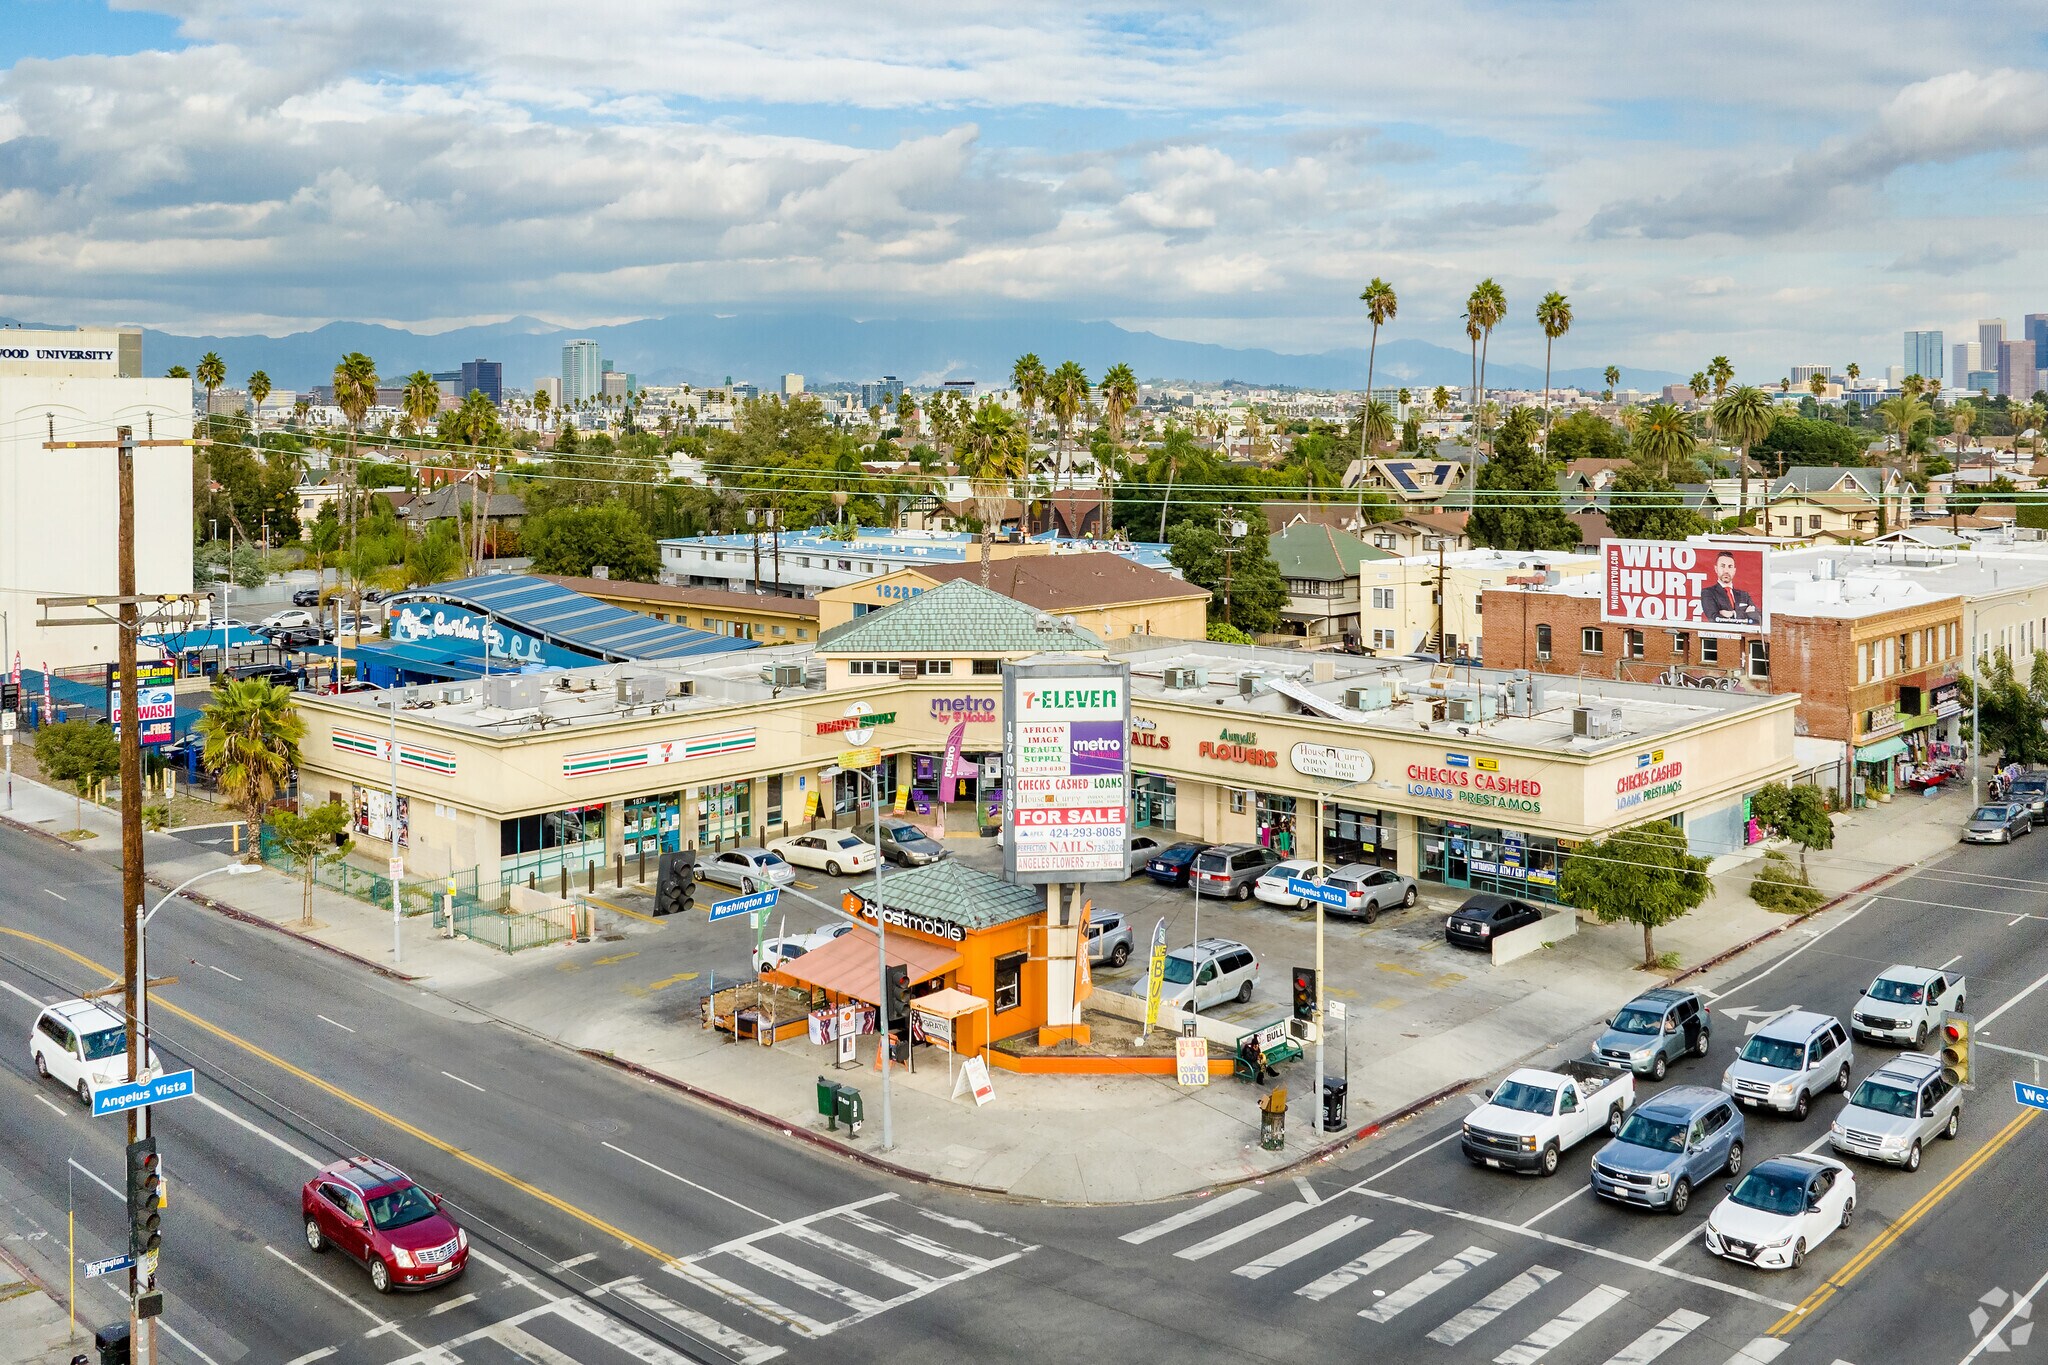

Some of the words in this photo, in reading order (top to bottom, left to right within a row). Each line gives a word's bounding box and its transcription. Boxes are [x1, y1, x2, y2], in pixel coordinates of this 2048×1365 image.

[36, 350, 113, 360] UNIVERSITY
[1620, 545, 1697, 571] WHO
[1611, 550, 1619, 610] WHOHURTYOU.COM
[1620, 569, 1708, 597] HURT
[876, 584, 909, 600] 1828
[1621, 595, 1705, 622] YOU?
[932, 695, 996, 711] metro
[816, 717, 859, 735] BEAUTY
[859, 711, 897, 729] SUPPLY
[938, 712, 951, 725] by
[963, 711, 996, 723] Mobile
[1023, 726, 1065, 734] AFRICAN
[1074, 738, 1120, 751] metro
[1131, 731, 1170, 750] AILS
[1024, 755, 1063, 763] SUPPLY
[1199, 741, 1279, 768] FLOWERS
[1300, 745, 1326, 757] House
[944, 745, 956, 777] metro
[1006, 765, 1015, 777] TO
[1617, 770, 1649, 793] CHECKS
[1651, 761, 1683, 784] CASHED
[1018, 779, 1051, 791] CHECKS
[1056, 778, 1089, 790] CASHED
[1094, 777, 1122, 789] LOANS
[1407, 764, 1469, 787] CHECKS
[1474, 773, 1542, 797] CASHED
[1407, 783, 1453, 801] LOANS
[1459, 790, 1542, 814] PRESTAMOS
[1643, 780, 1682, 801] PRESTAMOS
[1020, 811, 1062, 825] FOR
[1067, 809, 1121, 824] SALE
[1049, 827, 1122, 838] 424-293-8085
[1017, 844, 1047, 852] PERFECTION
[1049, 840, 1094, 853] NAILS
[1018, 859, 1050, 869] ANGELES
[1052, 857, 1084, 868] FLOWERS
[1293, 884, 1321, 898] Angelus
[1323, 891, 1343, 903] Vista
[715, 897, 763, 916] Washington
[765, 892, 774, 904] Bl
[1154, 945, 1167, 957] WE
[923, 1019, 949, 1033] GRATIS
[1267, 1029, 1284, 1042] BULL
[1179, 1040, 1190, 1048] WE
[1191, 1040, 1205, 1048] BUY
[1180, 1065, 1206, 1073] COMPRO
[1182, 1074, 1205, 1084] ORO
[102, 1089, 151, 1107] Angelus
[155, 1082, 187, 1096] Vista
[2022, 1088, 2048, 1104] We
[86, 1256, 124, 1271] Washington
